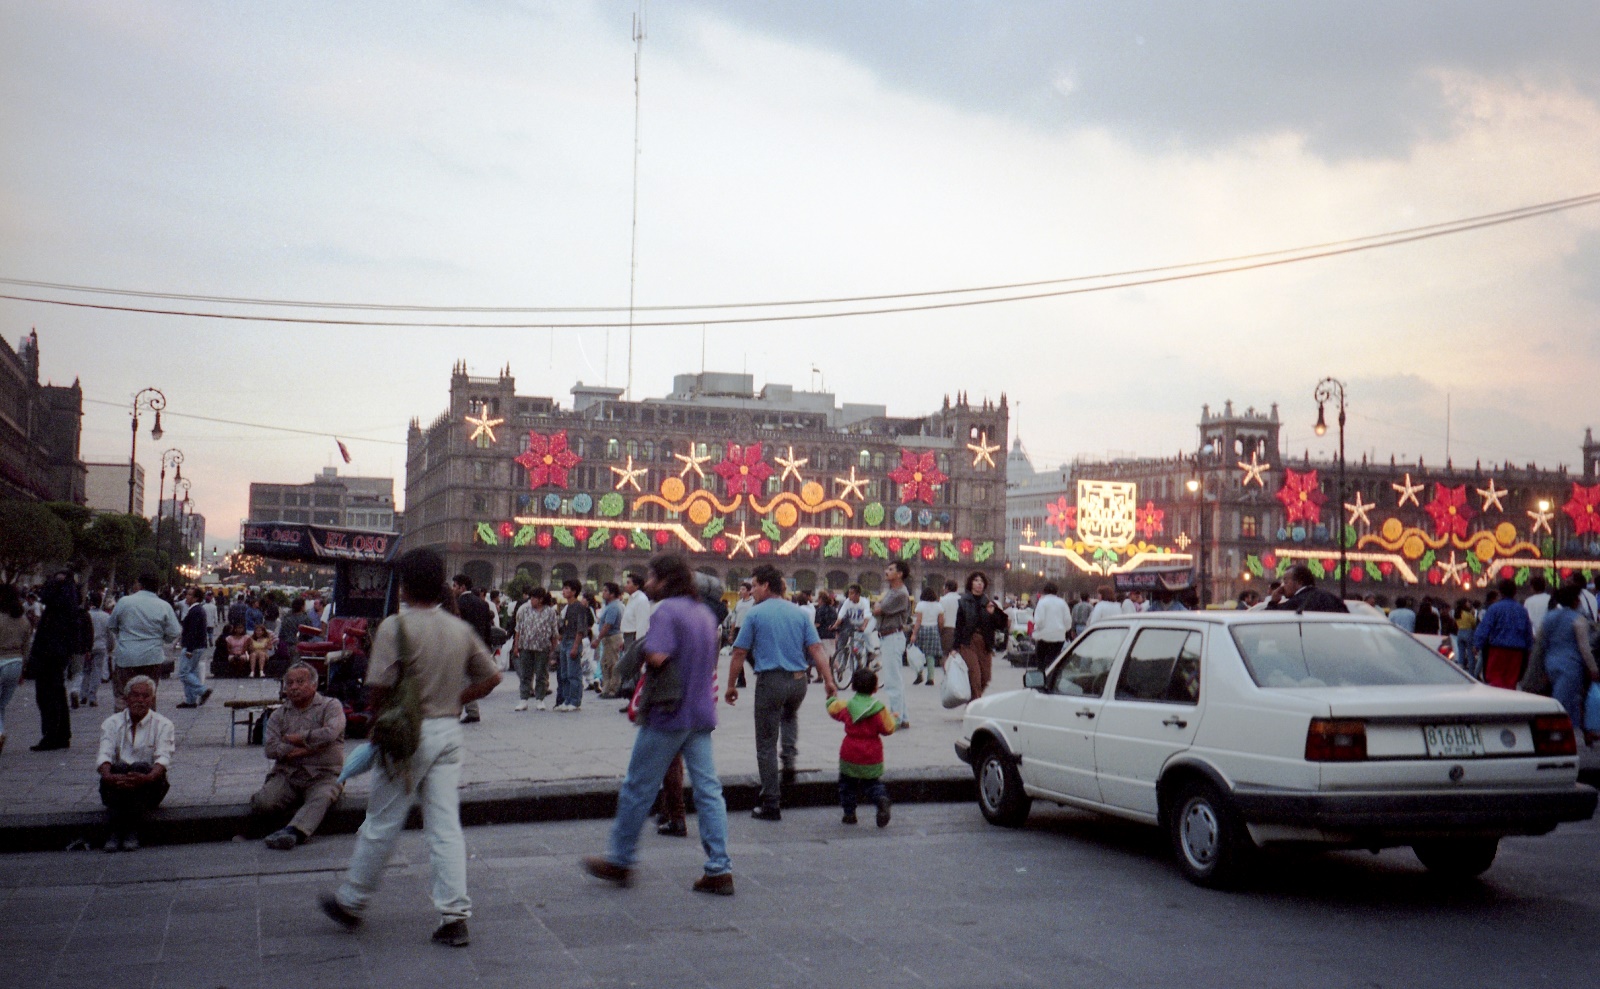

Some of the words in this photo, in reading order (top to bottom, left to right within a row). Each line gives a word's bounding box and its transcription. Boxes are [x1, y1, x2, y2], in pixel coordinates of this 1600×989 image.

[245, 528, 268, 540] EL
[271, 529, 301, 542] OSO
[324, 531, 348, 550] EL
[353, 535, 387, 553] OSO
[1428, 726, 1481, 746] 816HLH
